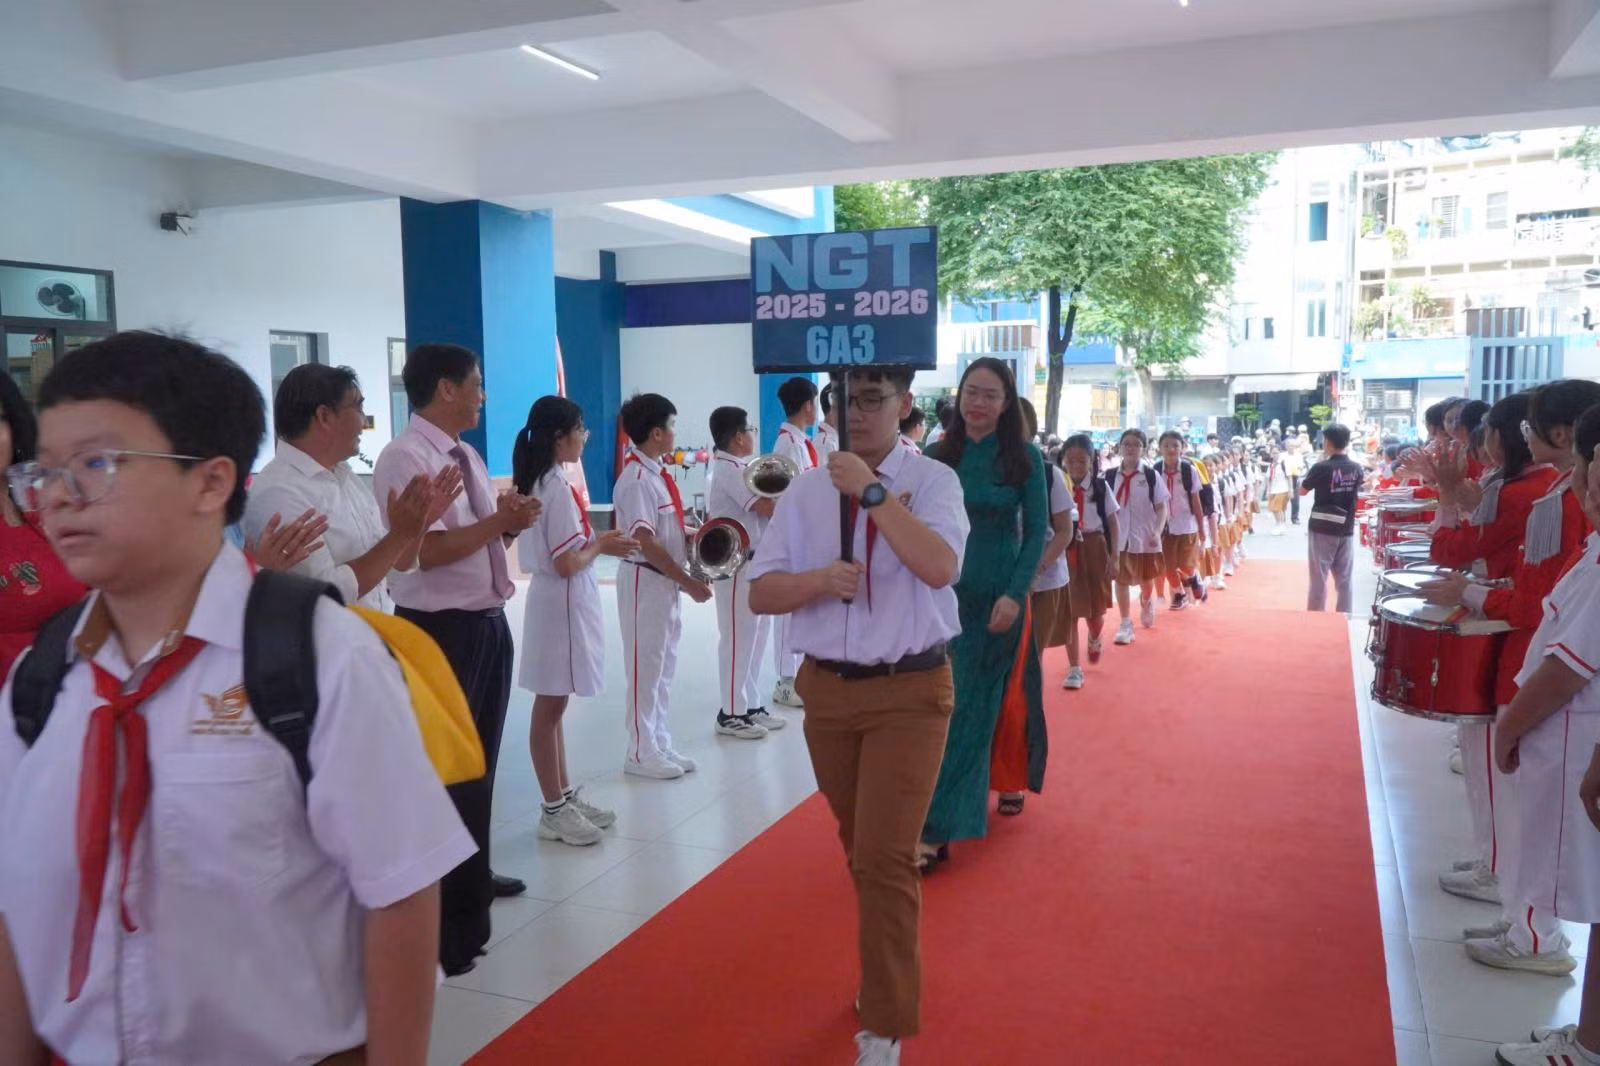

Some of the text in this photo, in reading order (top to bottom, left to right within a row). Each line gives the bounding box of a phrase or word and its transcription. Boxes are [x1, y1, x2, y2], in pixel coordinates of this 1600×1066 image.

[755, 228, 931, 293] NGT
[756, 293, 826, 320] 2025
[853, 289, 929, 317] 2026
[806, 324, 875, 365] 6A3
